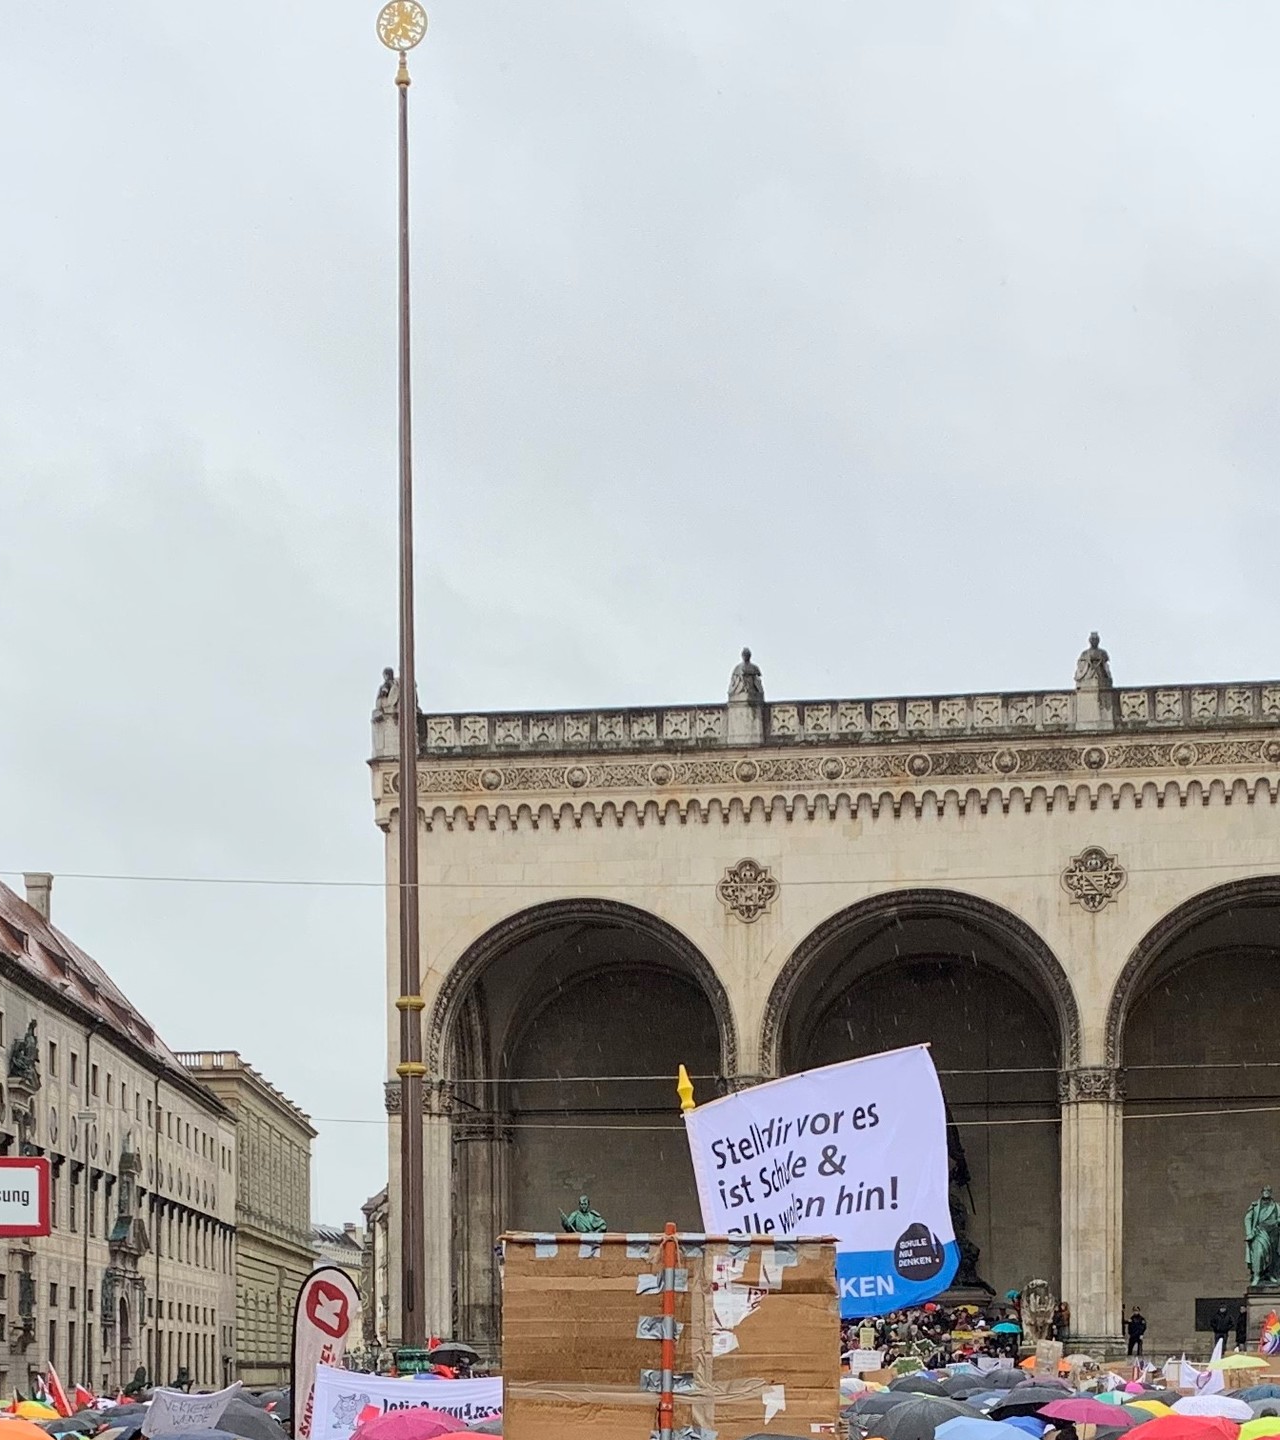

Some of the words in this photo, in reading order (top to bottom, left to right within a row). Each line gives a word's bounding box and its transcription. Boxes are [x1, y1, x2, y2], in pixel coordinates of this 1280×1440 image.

[711, 1122, 765, 1170] Stell
[761, 1116, 793, 1149] dir
[797, 1110, 844, 1138] vor
[852, 1102, 880, 1131] es
[718, 1174, 755, 1210] ist
[817, 1144, 847, 1177] &
[835, 1175, 899, 1217] hin!
[837, 1274, 895, 1299] KEN
